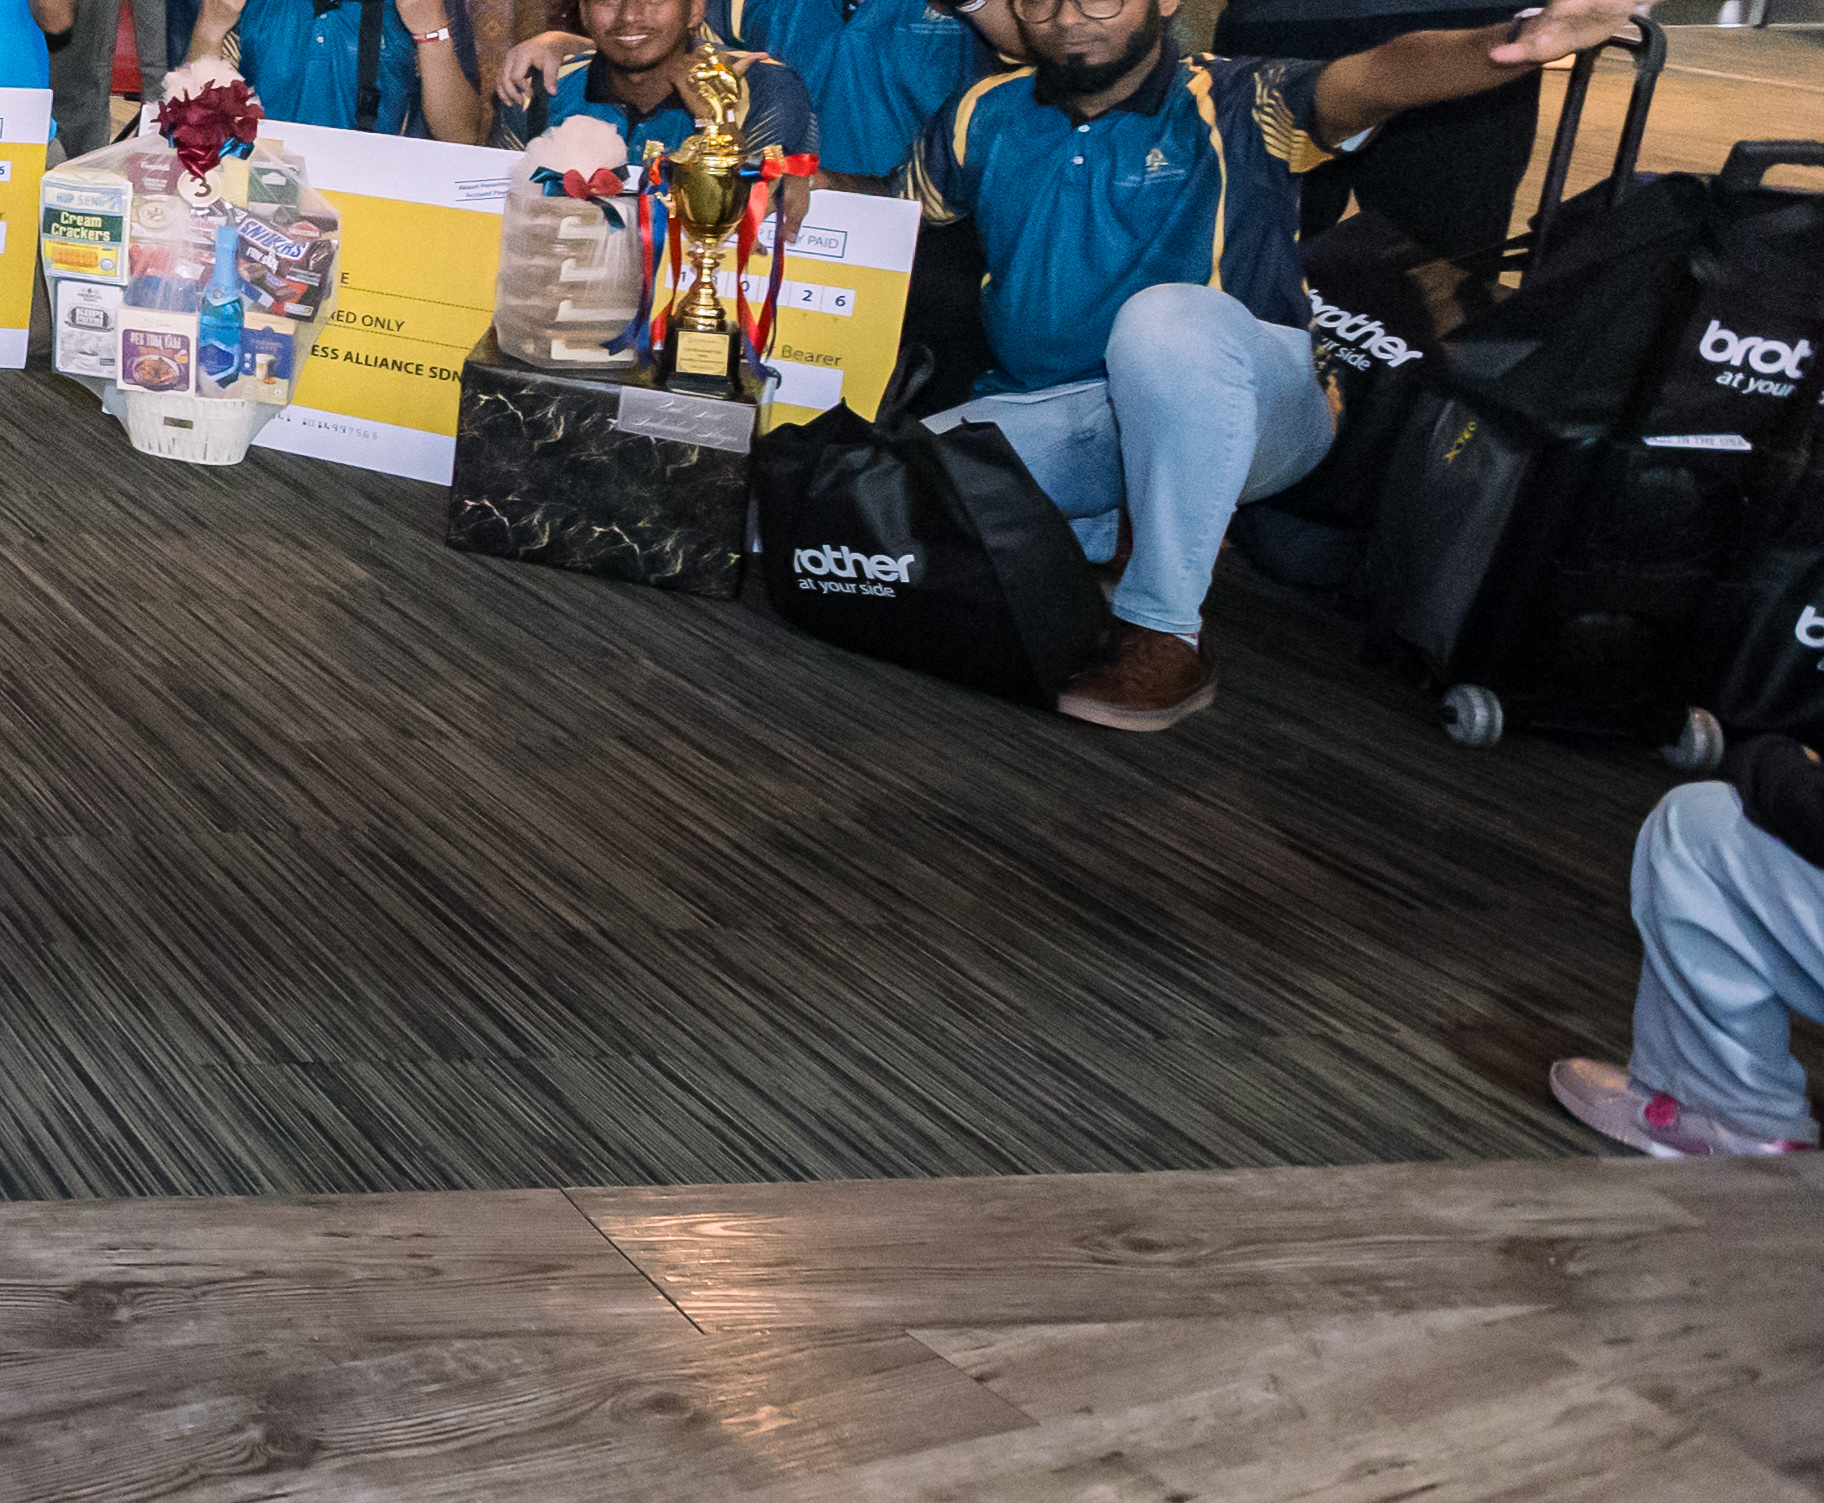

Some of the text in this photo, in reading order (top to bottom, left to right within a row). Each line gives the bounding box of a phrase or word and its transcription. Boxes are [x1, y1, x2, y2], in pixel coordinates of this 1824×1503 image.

[194, 176, 213, 198] 3
[60, 211, 102, 227] Cream
[51, 223, 111, 241] Crackers
[807, 236, 840, 249] PAID
[801, 290, 813, 302] 2
[834, 295, 846, 307] 6
[361, 315, 405, 332] ONLY
[781, 345, 842, 366] Bearer
[1334, 346, 1371, 371] side
[1699, 319, 1814, 380] brot
[343, 351, 424, 376] ALLIANCE
[1715, 371, 1796, 397] at your
[794, 544, 915, 583] rother
[798, 578, 896, 597] at your side
